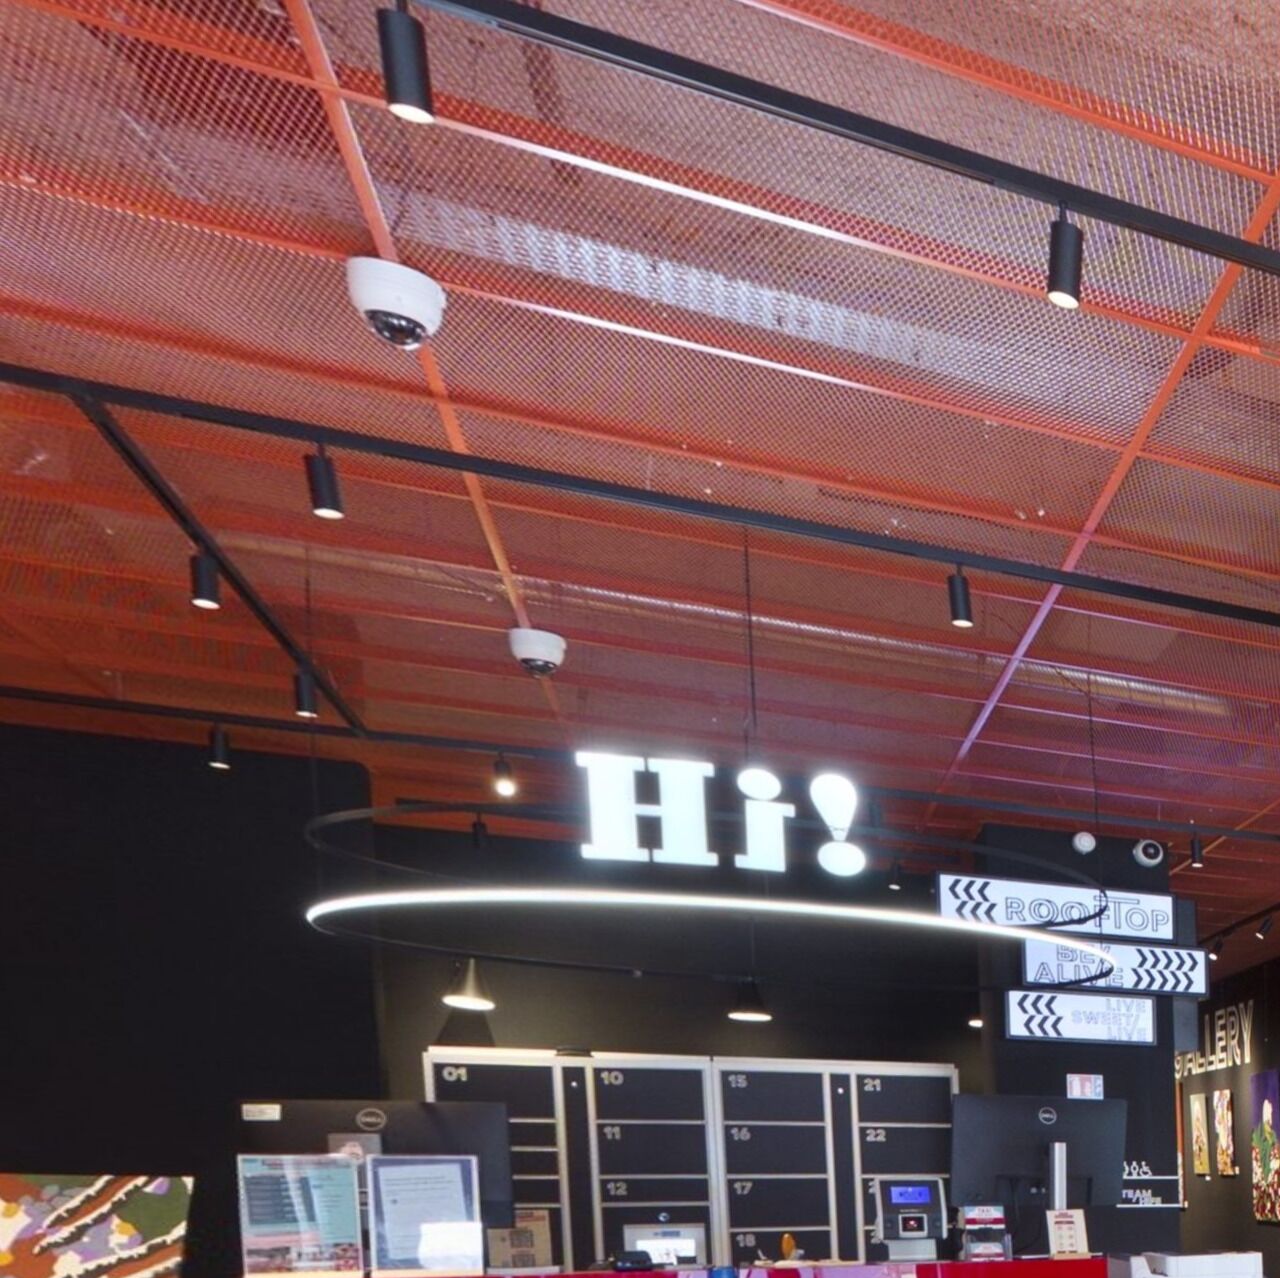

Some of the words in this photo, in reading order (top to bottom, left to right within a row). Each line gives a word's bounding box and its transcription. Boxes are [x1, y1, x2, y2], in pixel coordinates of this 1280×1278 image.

[575, 750, 867, 878] Hi!
[1005, 896, 1170, 933] ROOFTOP
[1034, 961, 1125, 988] ALIVE
[442, 1066, 468, 1082] 01
[600, 1071, 624, 1086] 10
[727, 1074, 748, 1089] 15
[863, 1079, 882, 1092] 21
[603, 1126, 622, 1140] 11
[730, 1127, 751, 1141] 16
[866, 1128, 887, 1142] 22
[606, 1181, 628, 1196] 12
[733, 1181, 753, 1195] 17
